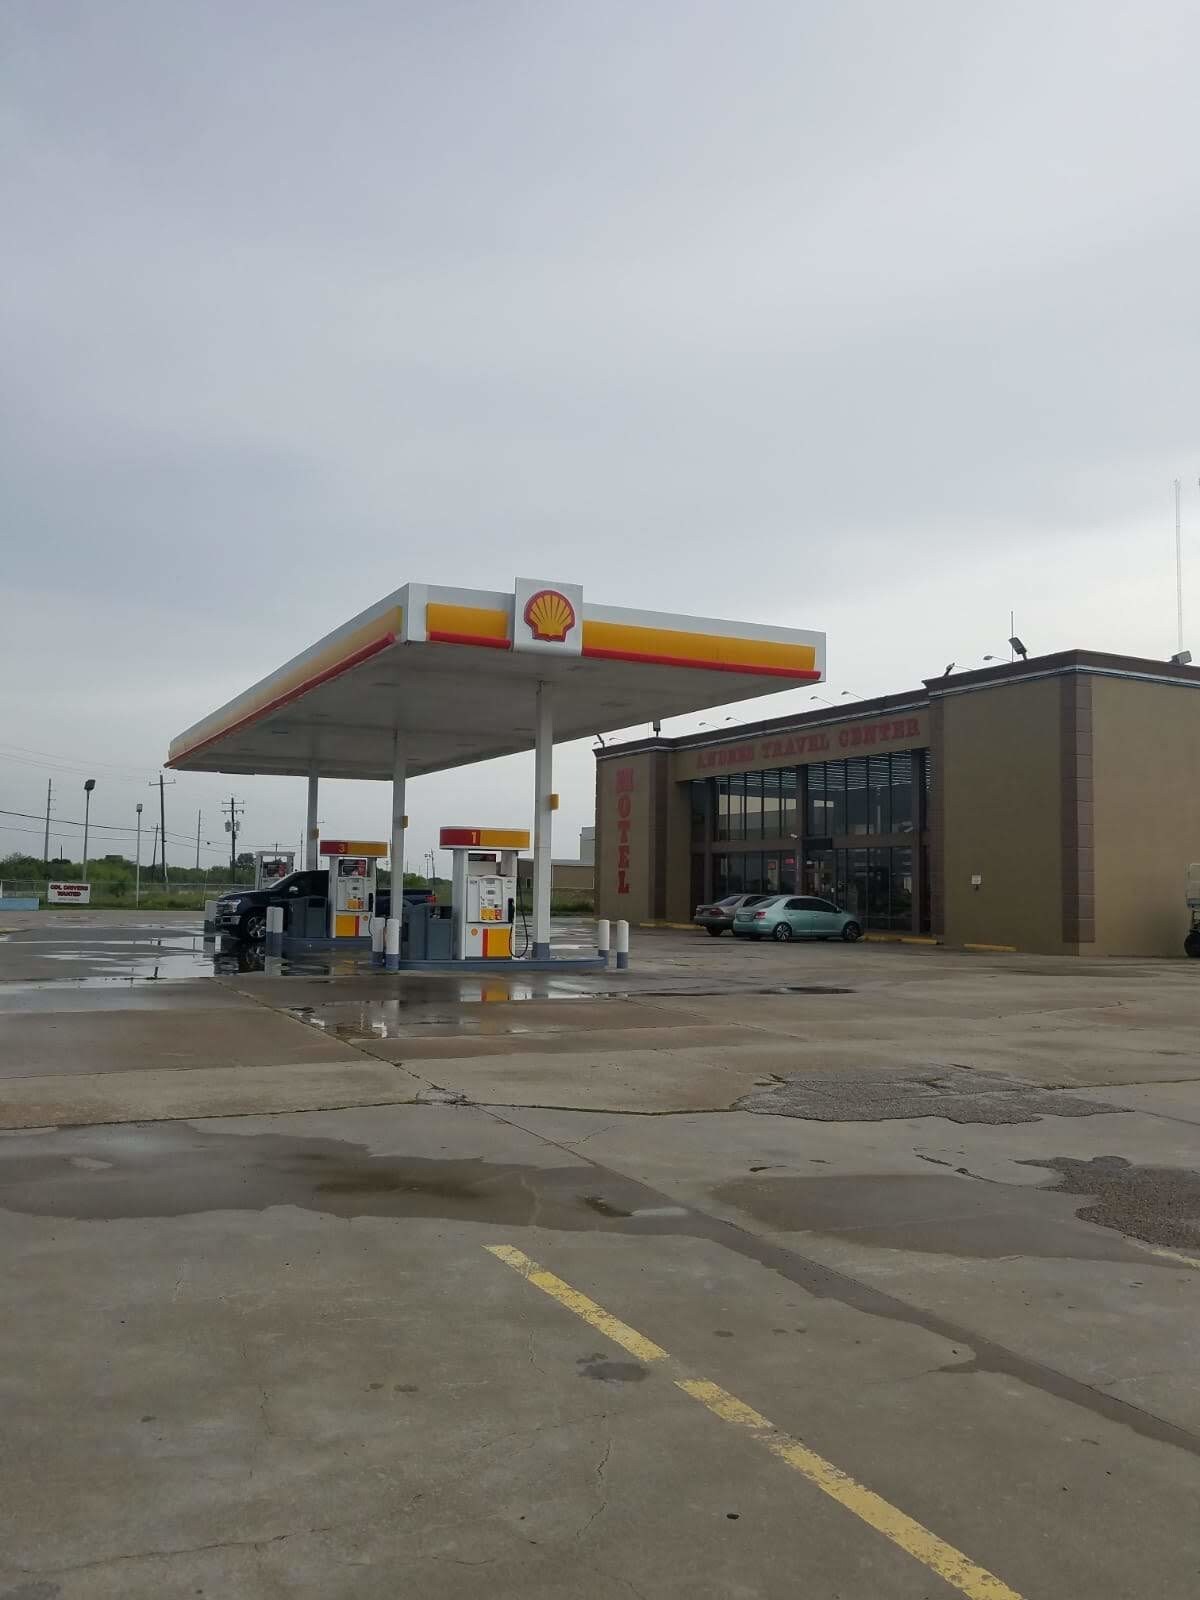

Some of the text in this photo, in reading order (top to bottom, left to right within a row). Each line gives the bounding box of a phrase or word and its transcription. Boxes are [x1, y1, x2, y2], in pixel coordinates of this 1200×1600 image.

[762, 733, 831, 759] TRAVEL
[838, 718, 921, 747] CENTER
[471, 831, 477, 845] 1
[338, 844, 345, 853] 3
